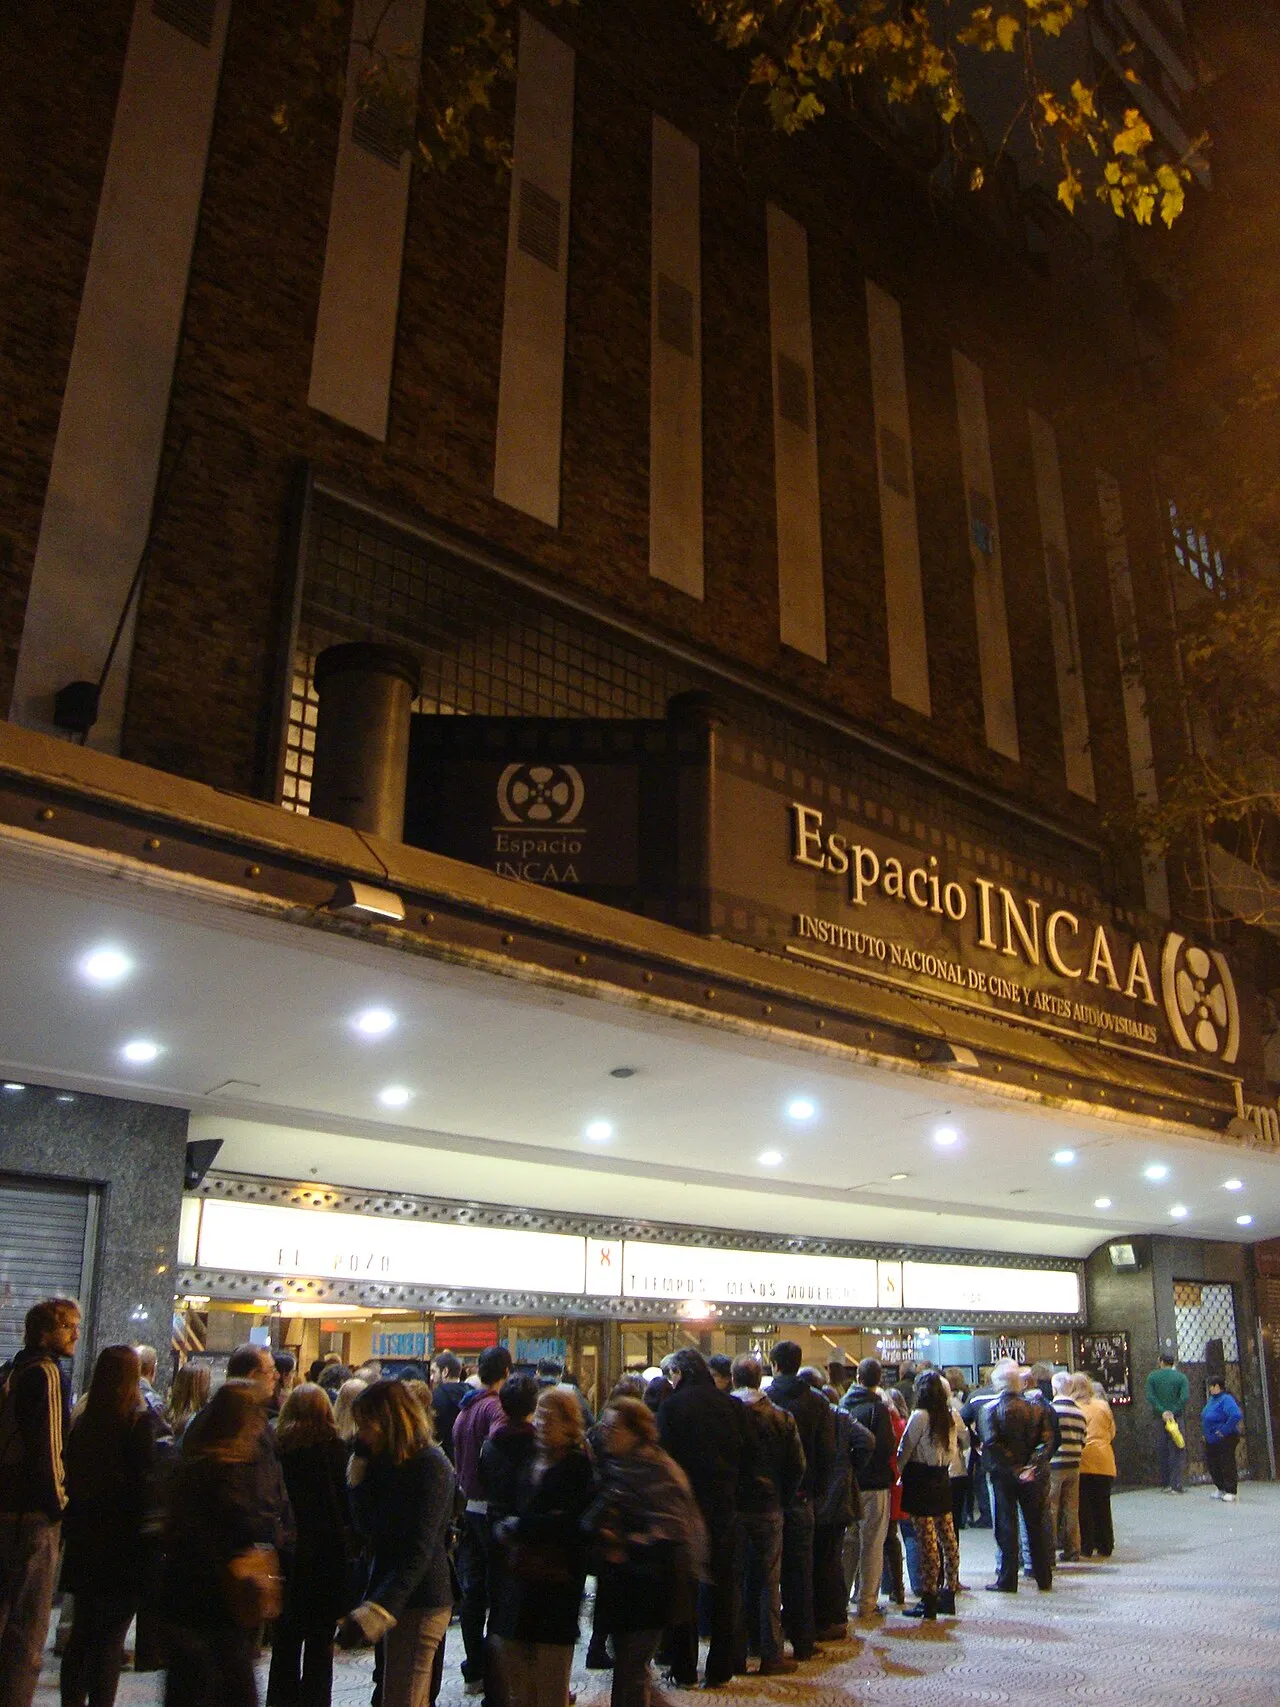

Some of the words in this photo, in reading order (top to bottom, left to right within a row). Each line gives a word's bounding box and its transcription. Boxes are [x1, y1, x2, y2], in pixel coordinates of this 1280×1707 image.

[495, 833, 582, 857] Espacio
[495, 861, 580, 883] INCAA
[791, 802, 968, 922] Espacio
[975, 877, 1158, 1007] INCAA
[797, 914, 887, 961] INSTITUTO
[890, 943, 966, 987] NACIONAL
[967, 968, 987, 991] DE
[988, 975, 1020, 1004] CINE
[1020, 988, 1032, 1007] Y
[1032, 989, 1071, 1019] ARTES
[1072, 1001, 1157, 1044] AUDIOVISUALES
